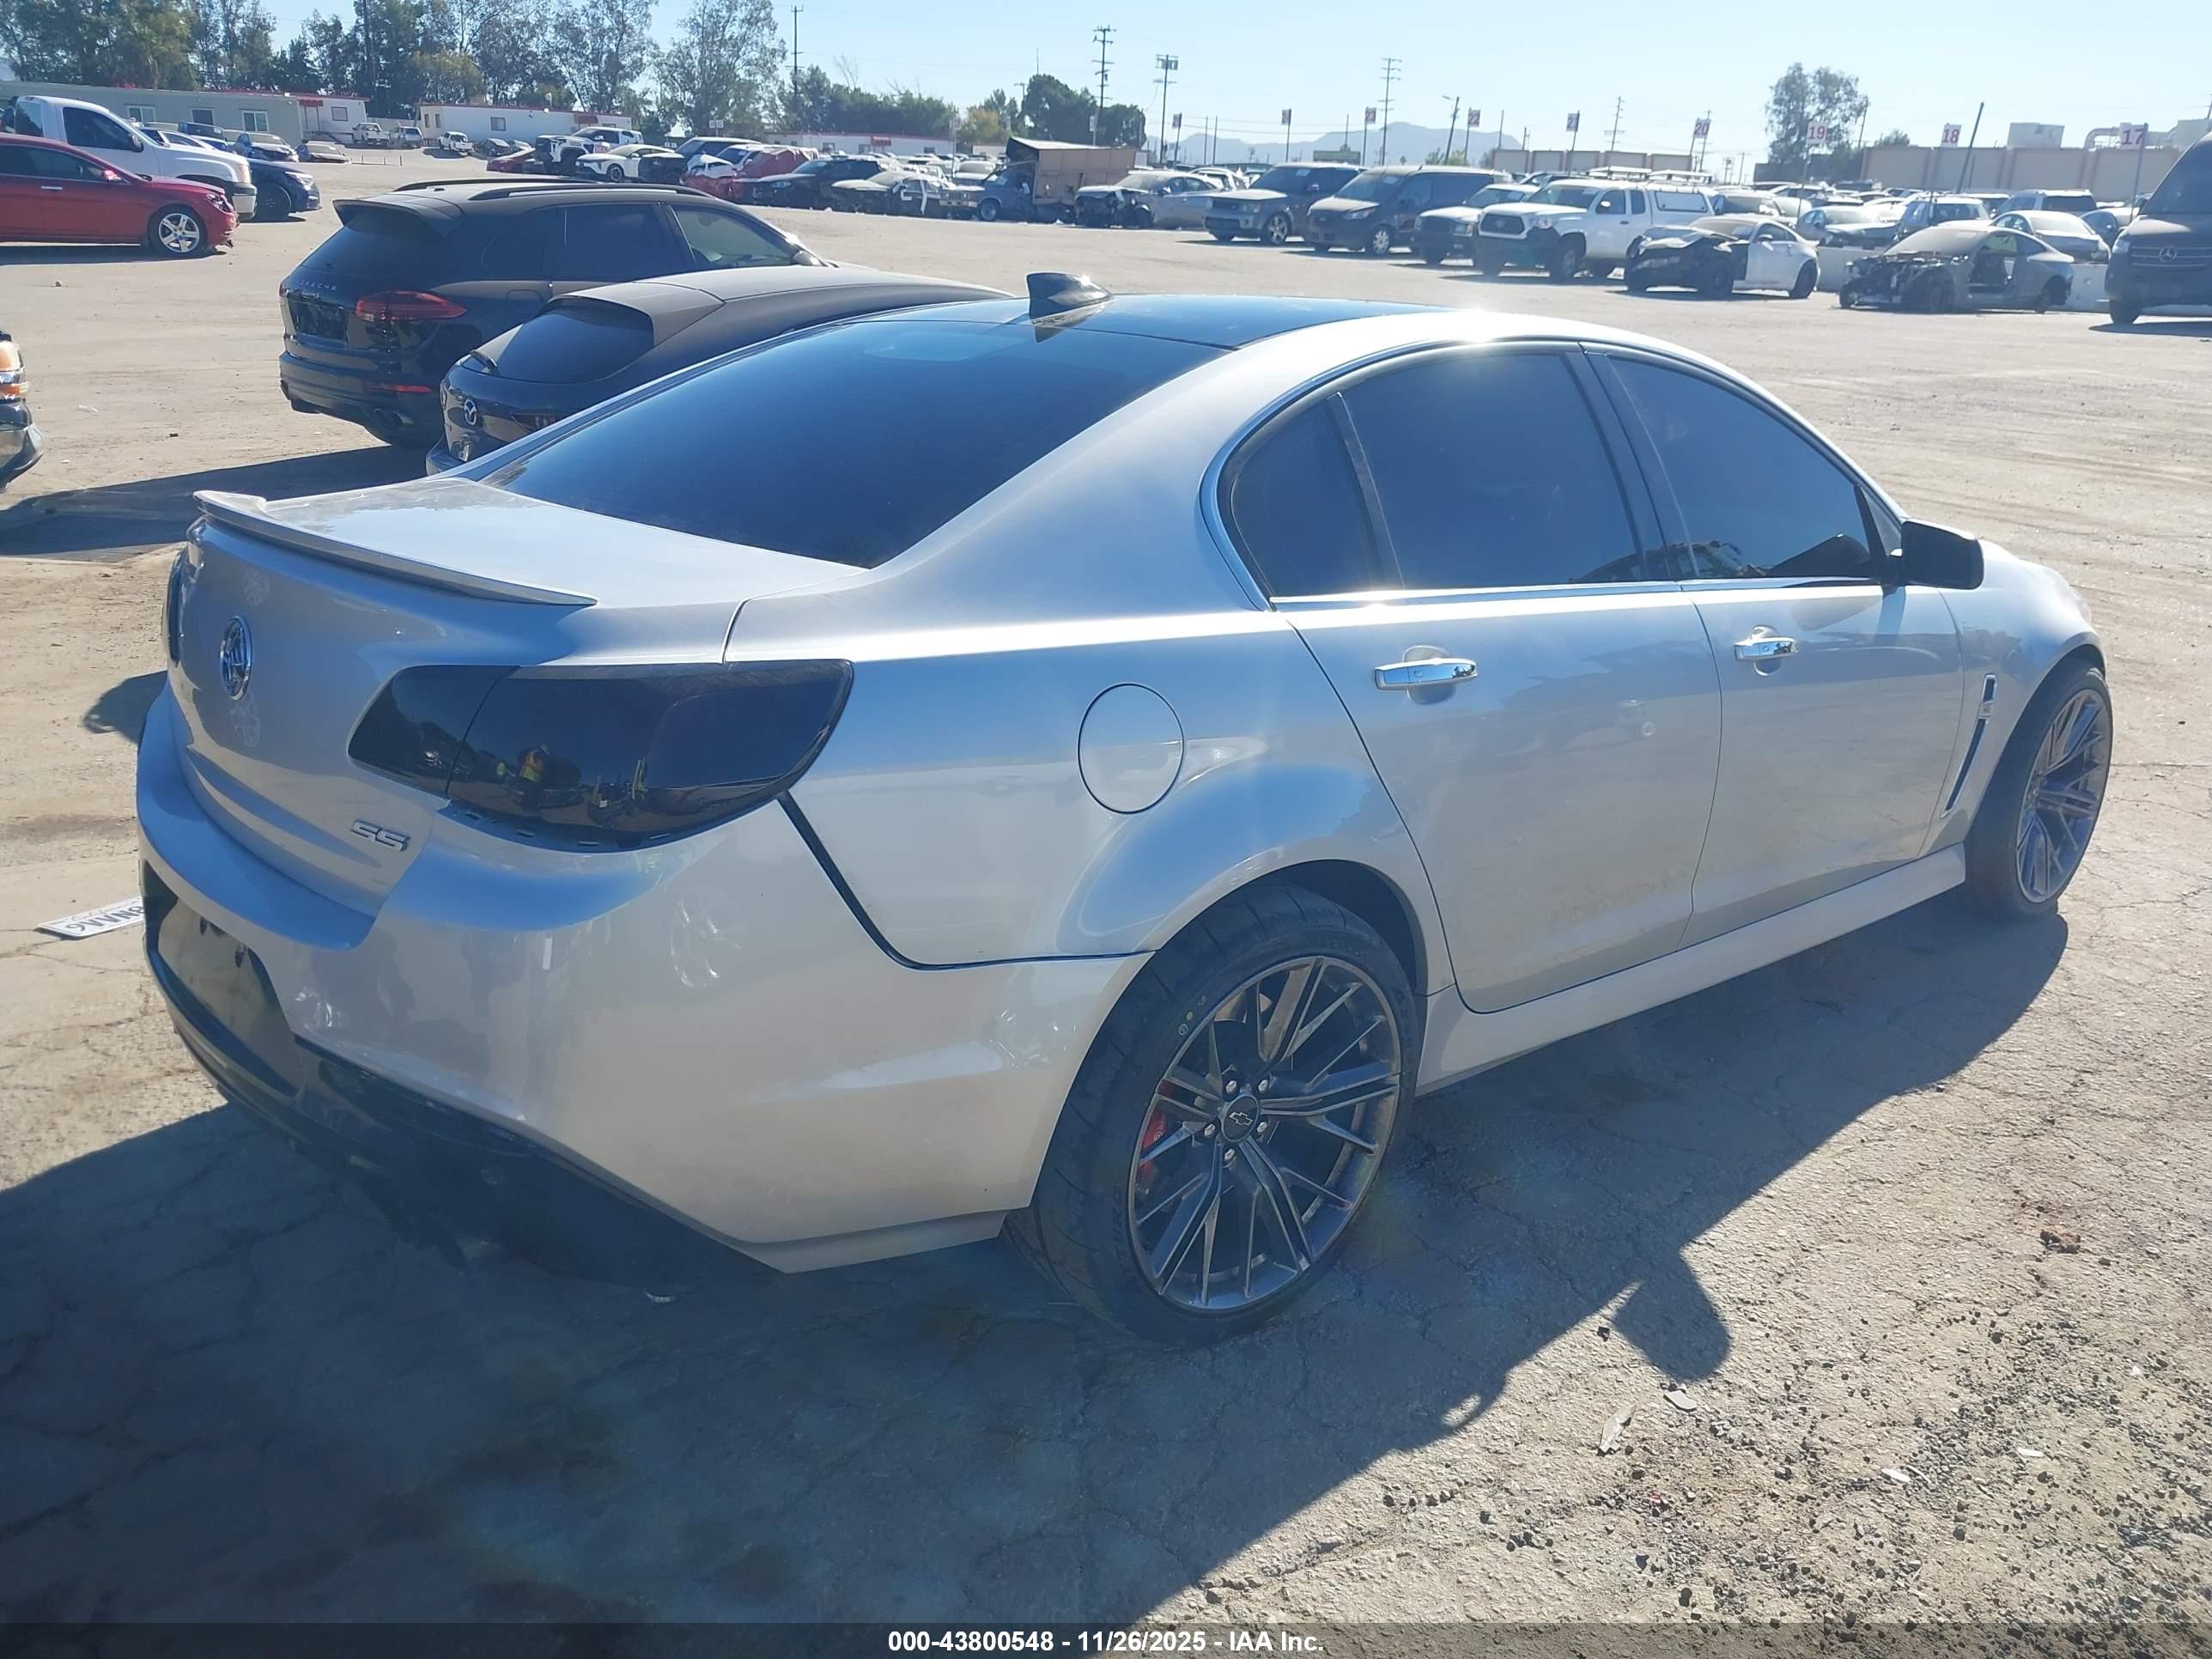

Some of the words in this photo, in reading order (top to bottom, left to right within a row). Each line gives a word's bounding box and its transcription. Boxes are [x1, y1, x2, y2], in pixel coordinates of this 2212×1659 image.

[1694, 123, 1711, 136] 20
[1809, 125, 1826, 140] 19
[1942, 129, 1960, 143] 18
[2121, 129, 2144, 145] 17
[349, 819, 410, 853] SS
